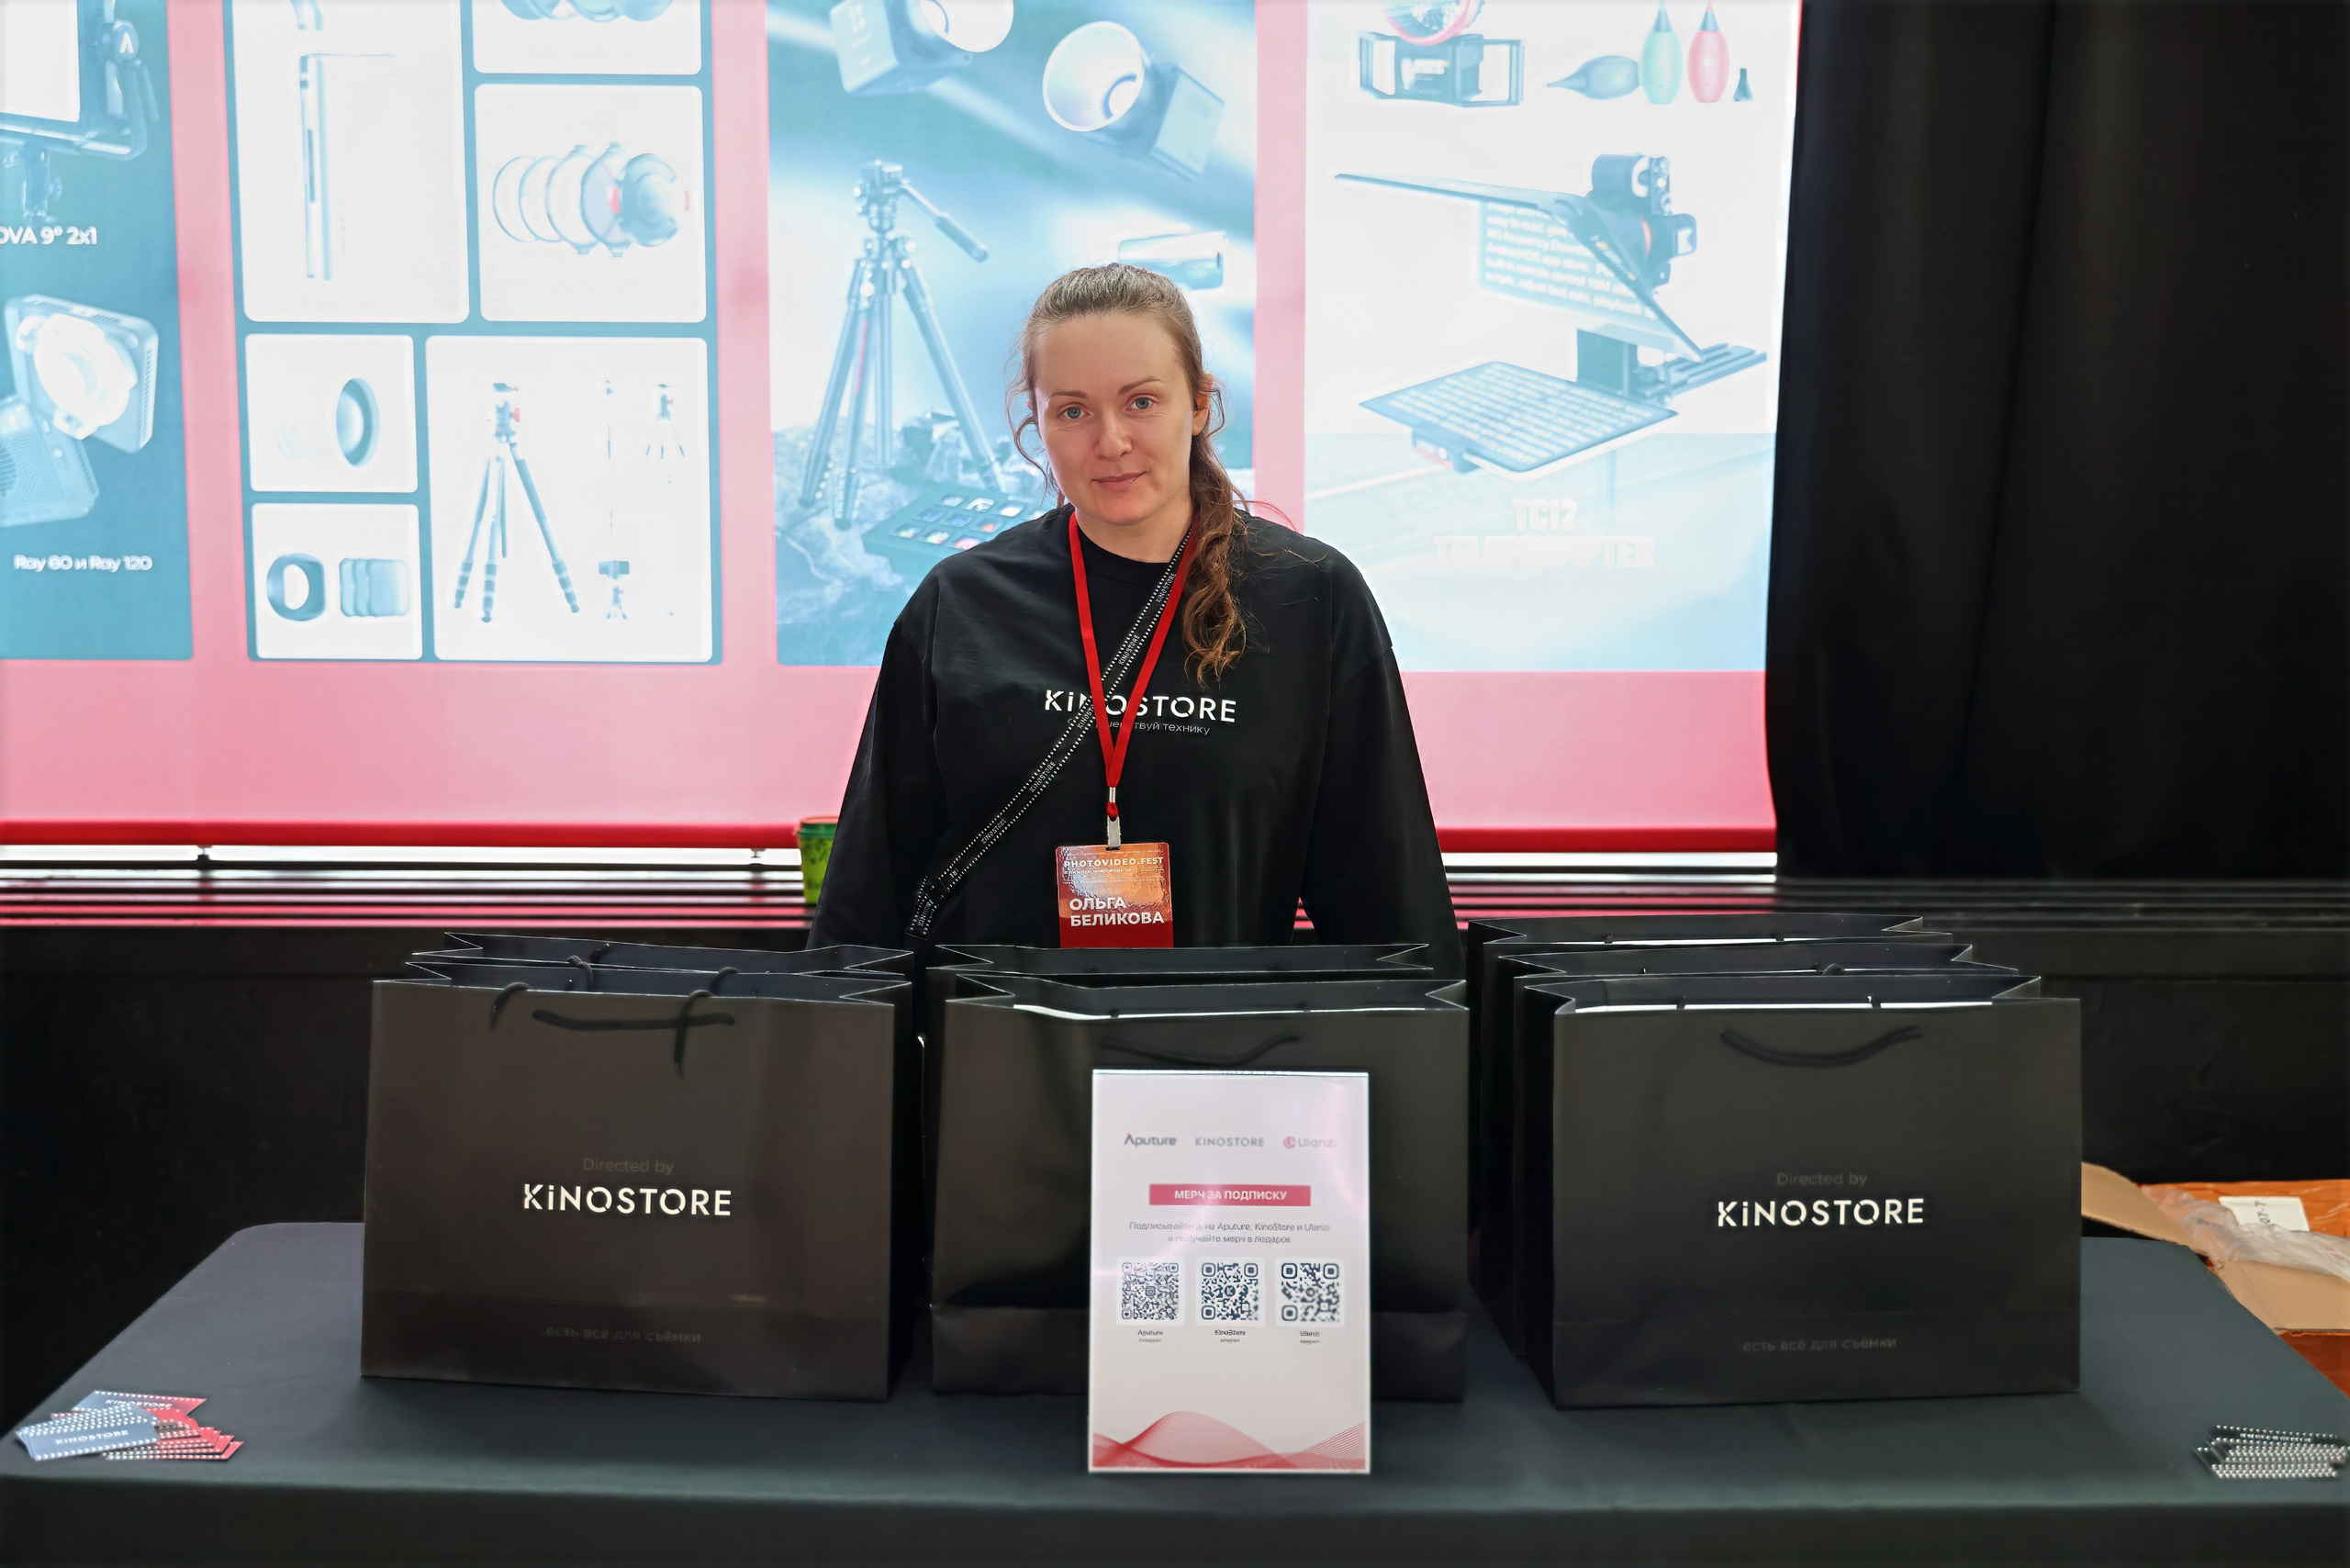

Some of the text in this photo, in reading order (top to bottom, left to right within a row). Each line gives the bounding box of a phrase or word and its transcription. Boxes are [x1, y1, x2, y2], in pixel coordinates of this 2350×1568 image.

[1512, 498, 1578, 532] TC12
[1163, 723, 1210, 735] технику
[1064, 857, 1164, 868] PHOTOVIDEO.FEST
[1069, 896, 1126, 911] ОЛЬГА
[1070, 912, 1165, 926] БЕЛИКОВА
[1125, 1133, 1177, 1148] Aputure
[583, 1158, 674, 1175] Directed by
[1776, 1171, 1867, 1187] Directed by
[1174, 1190, 1288, 1201] МЕРЧ ЗА ПОДПИСКУ
[546, 1327, 579, 1338] есть
[614, 1330, 641, 1340] для
[645, 1330, 700, 1343] съёмки
[1742, 1341, 1775, 1352] есть
[1810, 1340, 1837, 1350] для
[1842, 1338, 1897, 1350] съёмки
